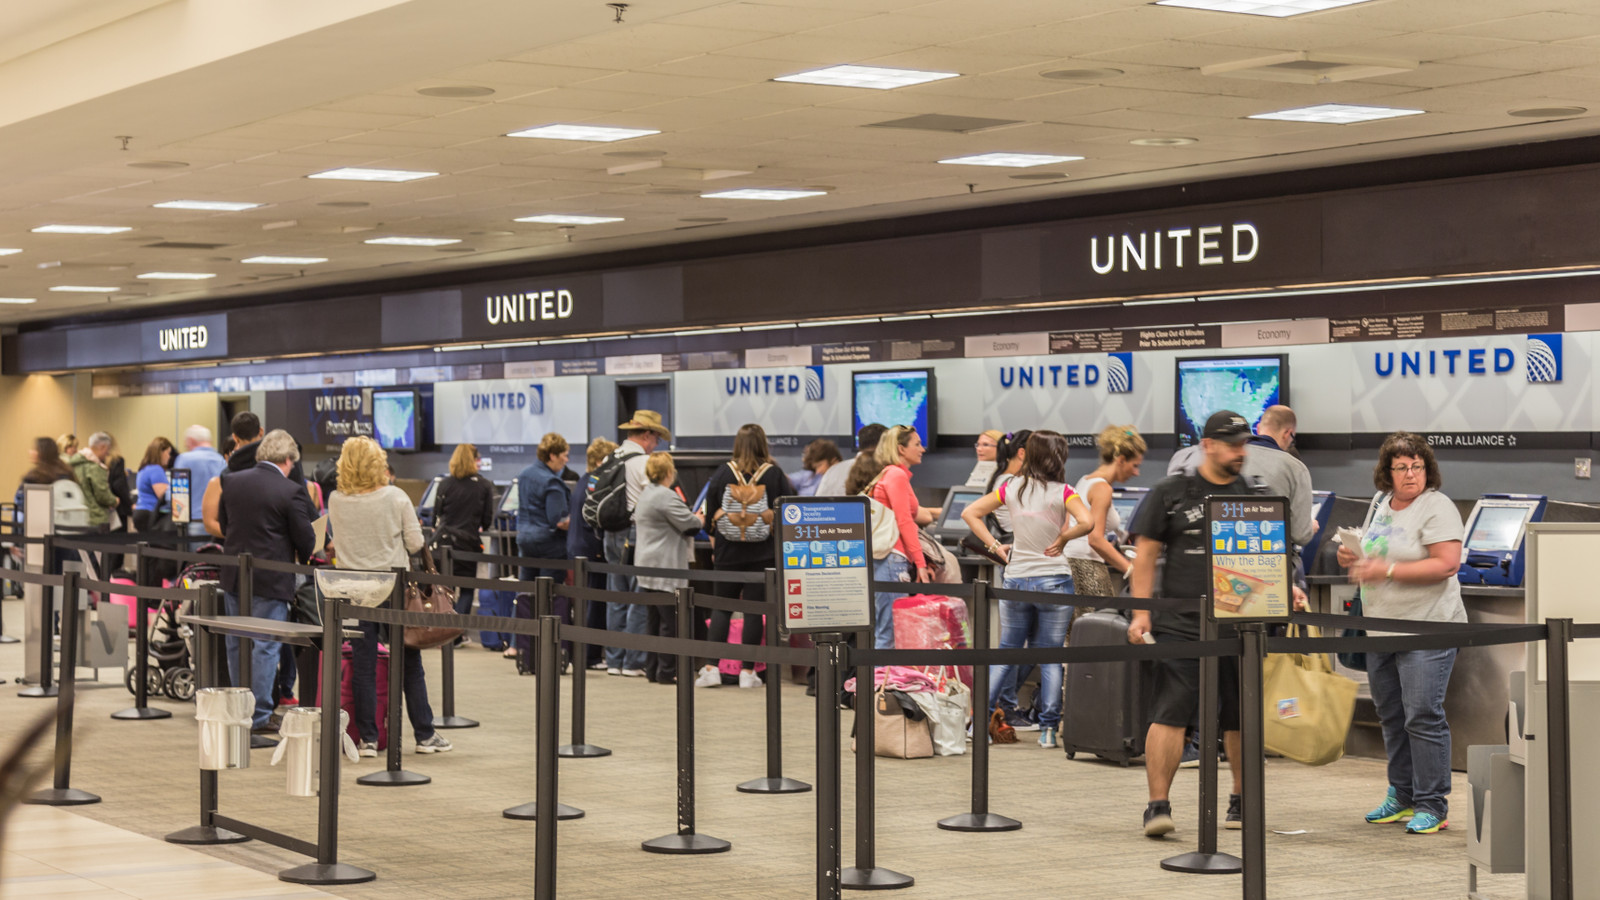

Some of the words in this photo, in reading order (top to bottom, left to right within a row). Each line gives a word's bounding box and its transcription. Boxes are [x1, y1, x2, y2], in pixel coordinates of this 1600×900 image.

[1091, 223, 1259, 274] UNITED
[486, 289, 574, 325] UNITED
[159, 325, 208, 352] UNITED
[1140, 331, 1155, 340] Flights
[1156, 330, 1168, 338] Close
[1169, 330, 1178, 338] Out
[1185, 329, 1205, 337] Minutes
[1257, 329, 1291, 340] Economy
[993, 341, 1020, 351] Economy
[1157, 338, 1181, 346] Scheduled
[1181, 338, 1205, 347] Departure
[1375, 348, 1515, 376] UNITED
[1000, 364, 1099, 388] UNITED
[726, 375, 799, 396] UNITED
[315, 395, 361, 412] UNITED
[471, 392, 526, 411] UNITED
[326, 420, 351, 435] Premier
[1066, 436, 1093, 446] LIANCE
[1427, 435, 1453, 446] STAR
[1455, 435, 1504, 446] ALLIANCE
[1221, 502, 1244, 517] 3-1-1
[794, 525, 820, 539] 3-1-1
[785, 542, 791, 552] 3
[1216, 555, 1235, 568] Why
[1239, 555, 1254, 566] the
[1258, 554, 1282, 568] Bag?
